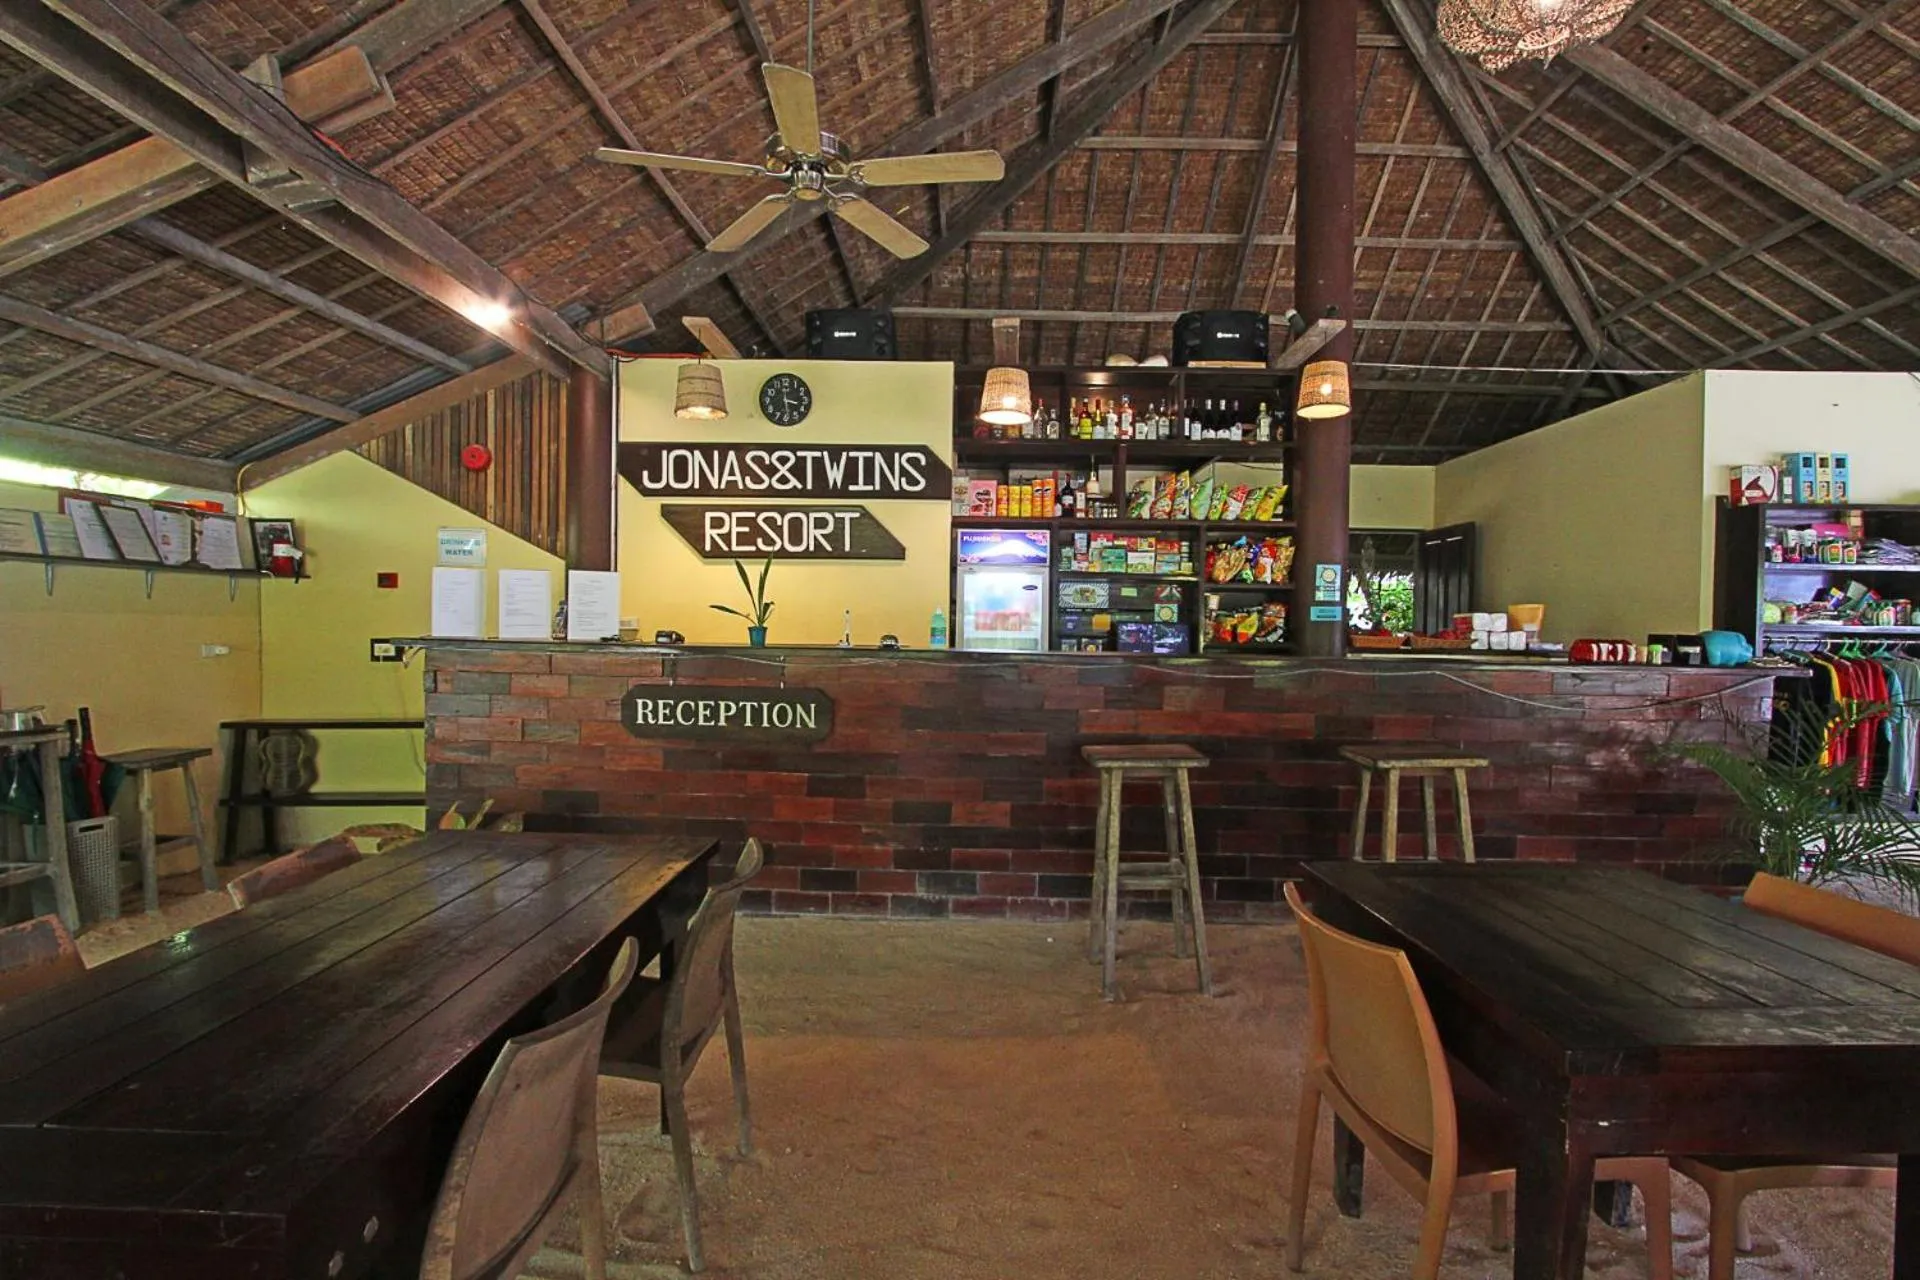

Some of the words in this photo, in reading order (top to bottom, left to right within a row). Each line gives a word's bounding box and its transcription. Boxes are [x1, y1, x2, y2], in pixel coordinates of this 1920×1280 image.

[767, 388, 775, 396] 10
[799, 387, 805, 396] 2
[774, 411, 781, 420] 7
[642, 449, 927, 492] JONAS&TWINS
[704, 511, 861, 553] RESORT
[635, 698, 816, 729] RECEPTION
